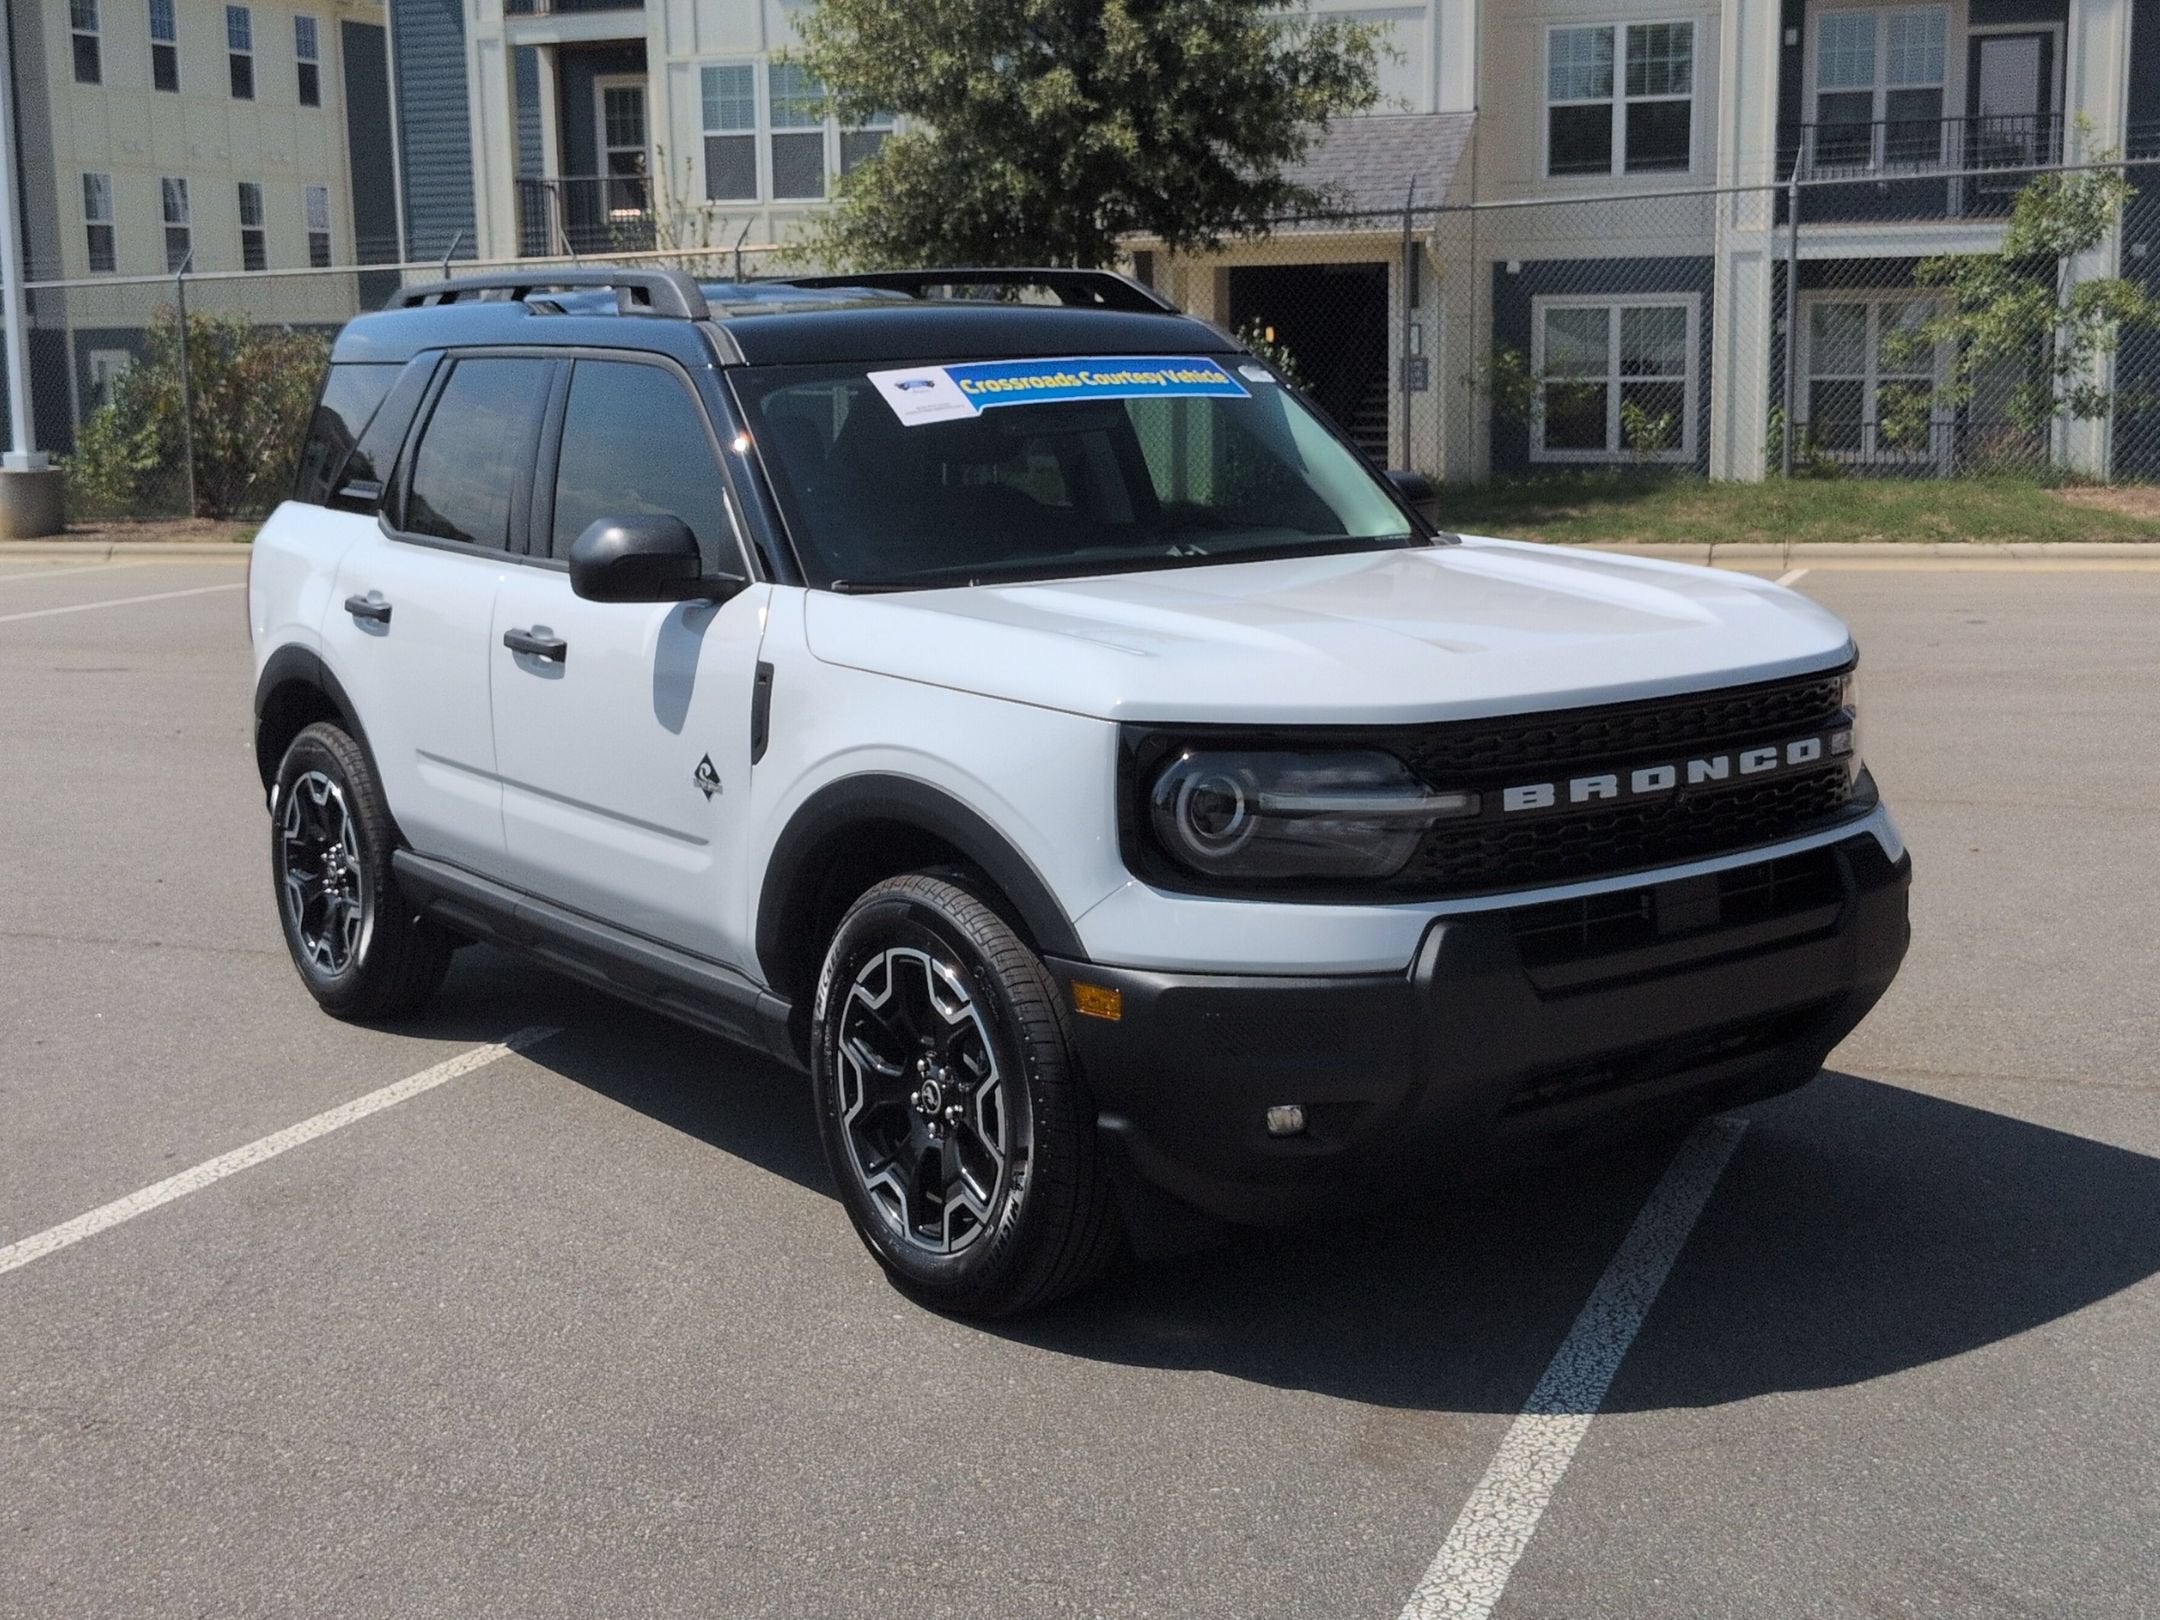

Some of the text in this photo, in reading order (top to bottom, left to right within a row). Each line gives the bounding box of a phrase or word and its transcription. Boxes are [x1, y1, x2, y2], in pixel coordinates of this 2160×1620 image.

[960, 368, 1230, 394] Crossroads Courtesy Vehicle
[1503, 737, 1821, 812] BRONCO
